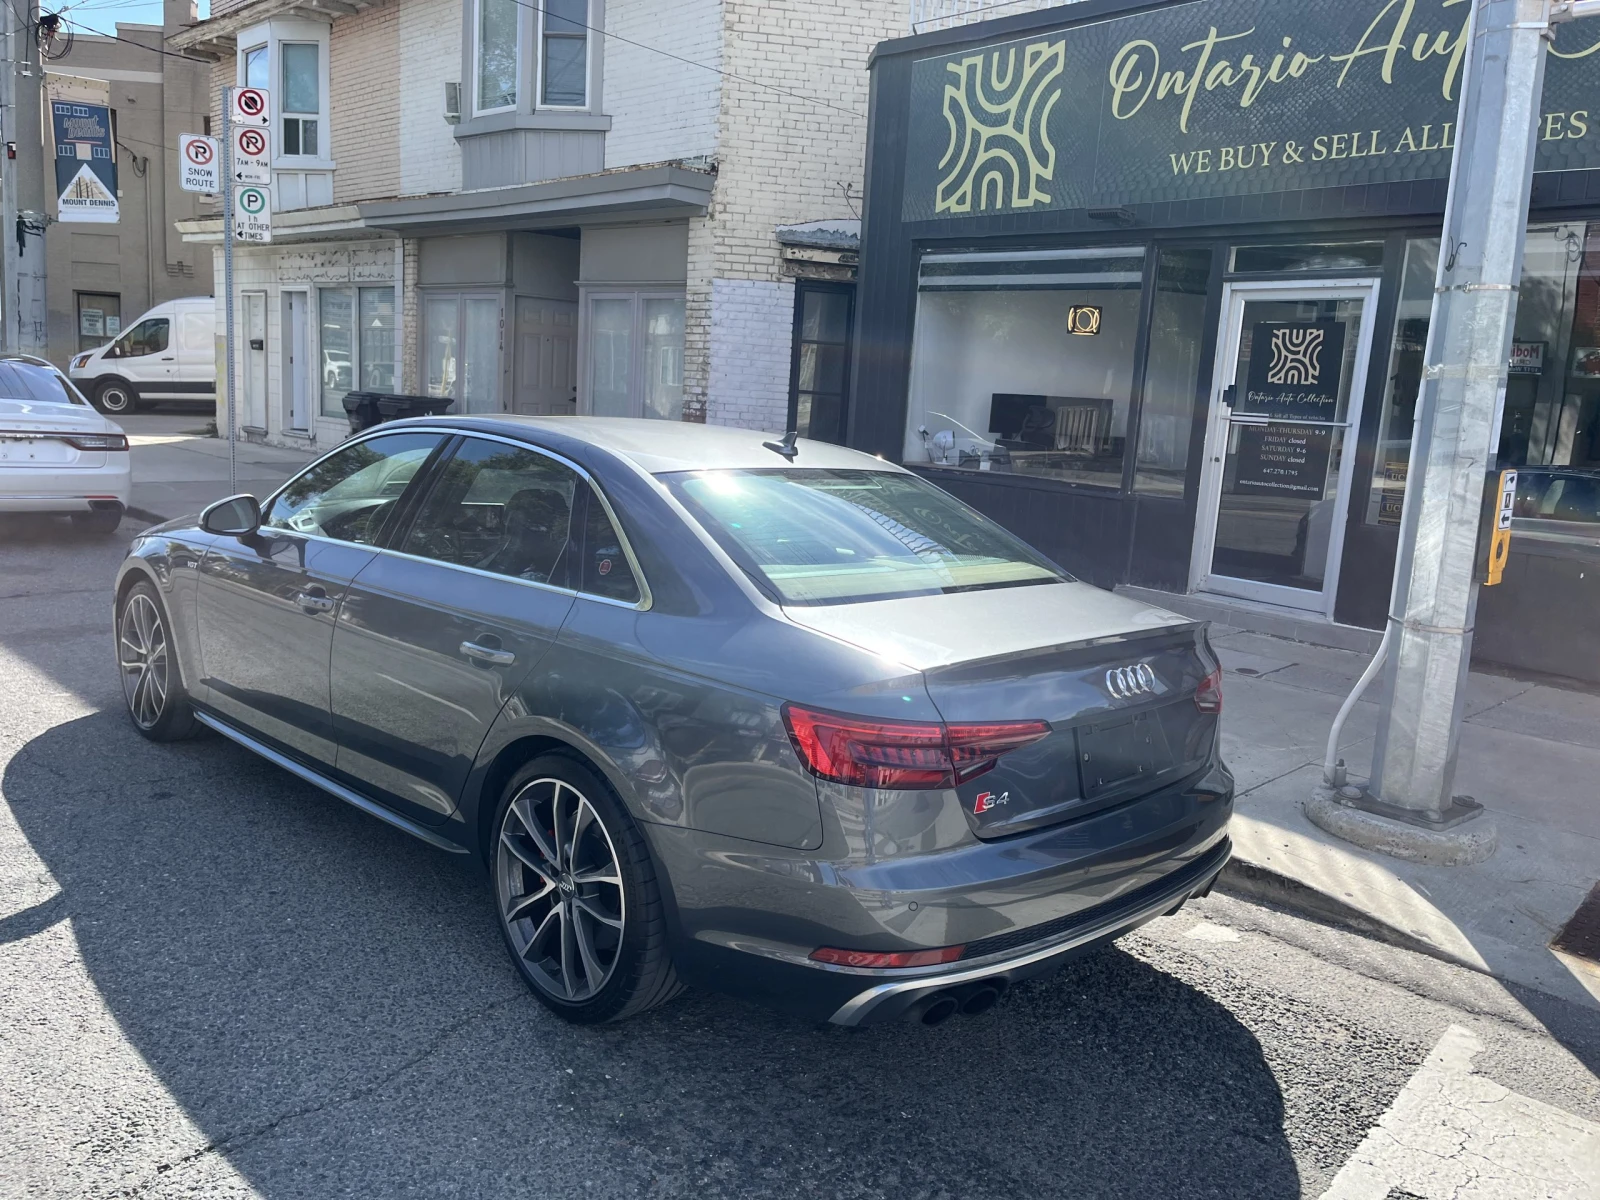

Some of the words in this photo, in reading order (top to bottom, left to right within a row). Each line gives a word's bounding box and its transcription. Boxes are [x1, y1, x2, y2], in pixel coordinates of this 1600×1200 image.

[1109, 26, 1325, 134] Ontario
[1329, 0, 1473, 101] Aut
[1169, 150, 1212, 176] WE
[1218, 141, 1278, 171] BUY
[1282, 140, 1304, 164] &
[1311, 129, 1387, 161] SELL
[1393, 122, 1455, 153] ALL
[1537, 110, 1589, 141] ES
[236, 157, 249, 166] 7AM
[255, 159, 268, 167] 9AM
[188, 167, 213, 177] SNOW
[185, 177, 215, 188] ROUTE
[62, 198, 88, 206] MOUNT
[89, 199, 116, 207] DENNIS
[247, 194, 258, 208] P
[236, 222, 247, 230] AT
[248, 222, 270, 232] OTHER
[244, 231, 263, 241] TIMES
[1248, 390, 1273, 404] Ontario
[1275, 392, 1296, 405] Auto
[1296, 392, 1334, 406] Collection
[1248, 426, 1313, 435] MONDAY-THURSDAY
[1264, 435, 1287, 443] FRIDAY
[1261, 444, 1295, 453] SATURDAY
[1260, 454, 1287, 462] SUNDAY
[978, 791, 1010, 810] S4
